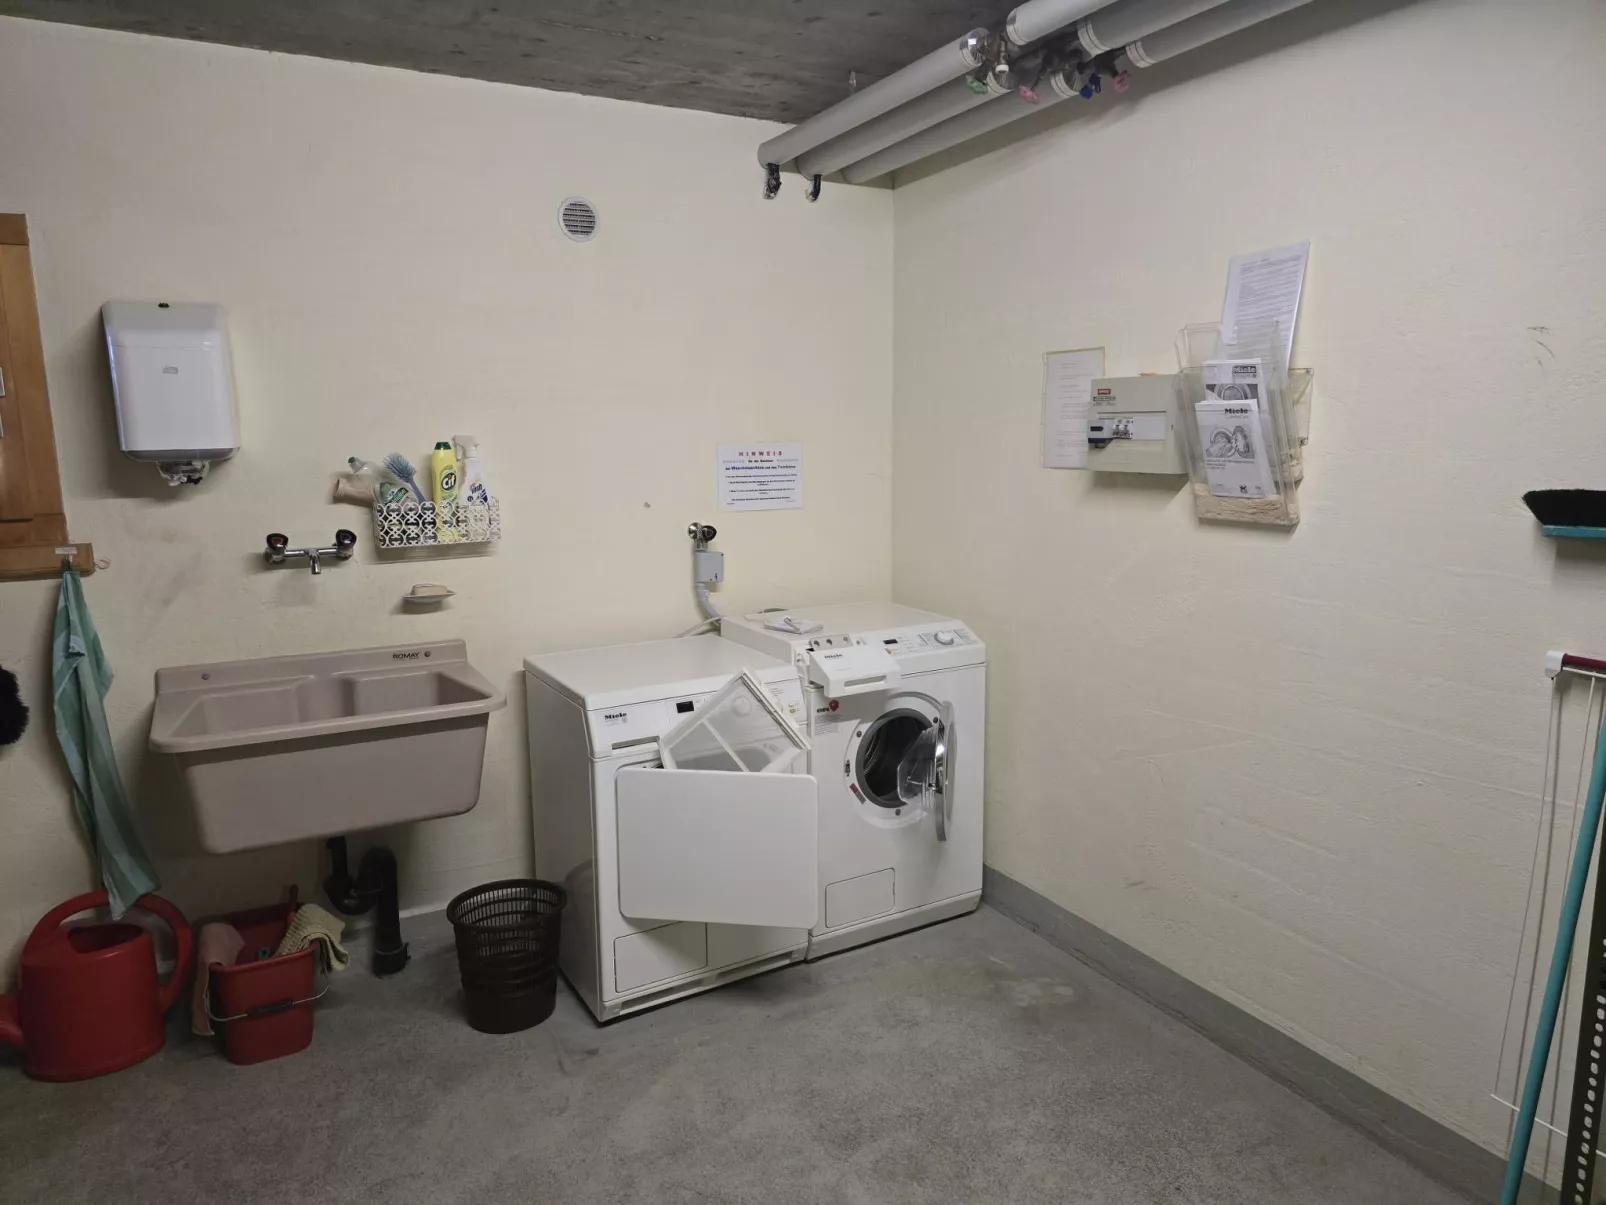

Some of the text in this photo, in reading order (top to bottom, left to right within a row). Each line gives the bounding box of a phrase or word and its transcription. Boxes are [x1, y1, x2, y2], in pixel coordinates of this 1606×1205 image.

[1233, 365, 1257, 374] Miele
[1224, 407, 1249, 415] Miele
[442, 474, 456, 489] Cif
[392, 652, 420, 660] ROMAY
[604, 712, 627, 720] Miele
